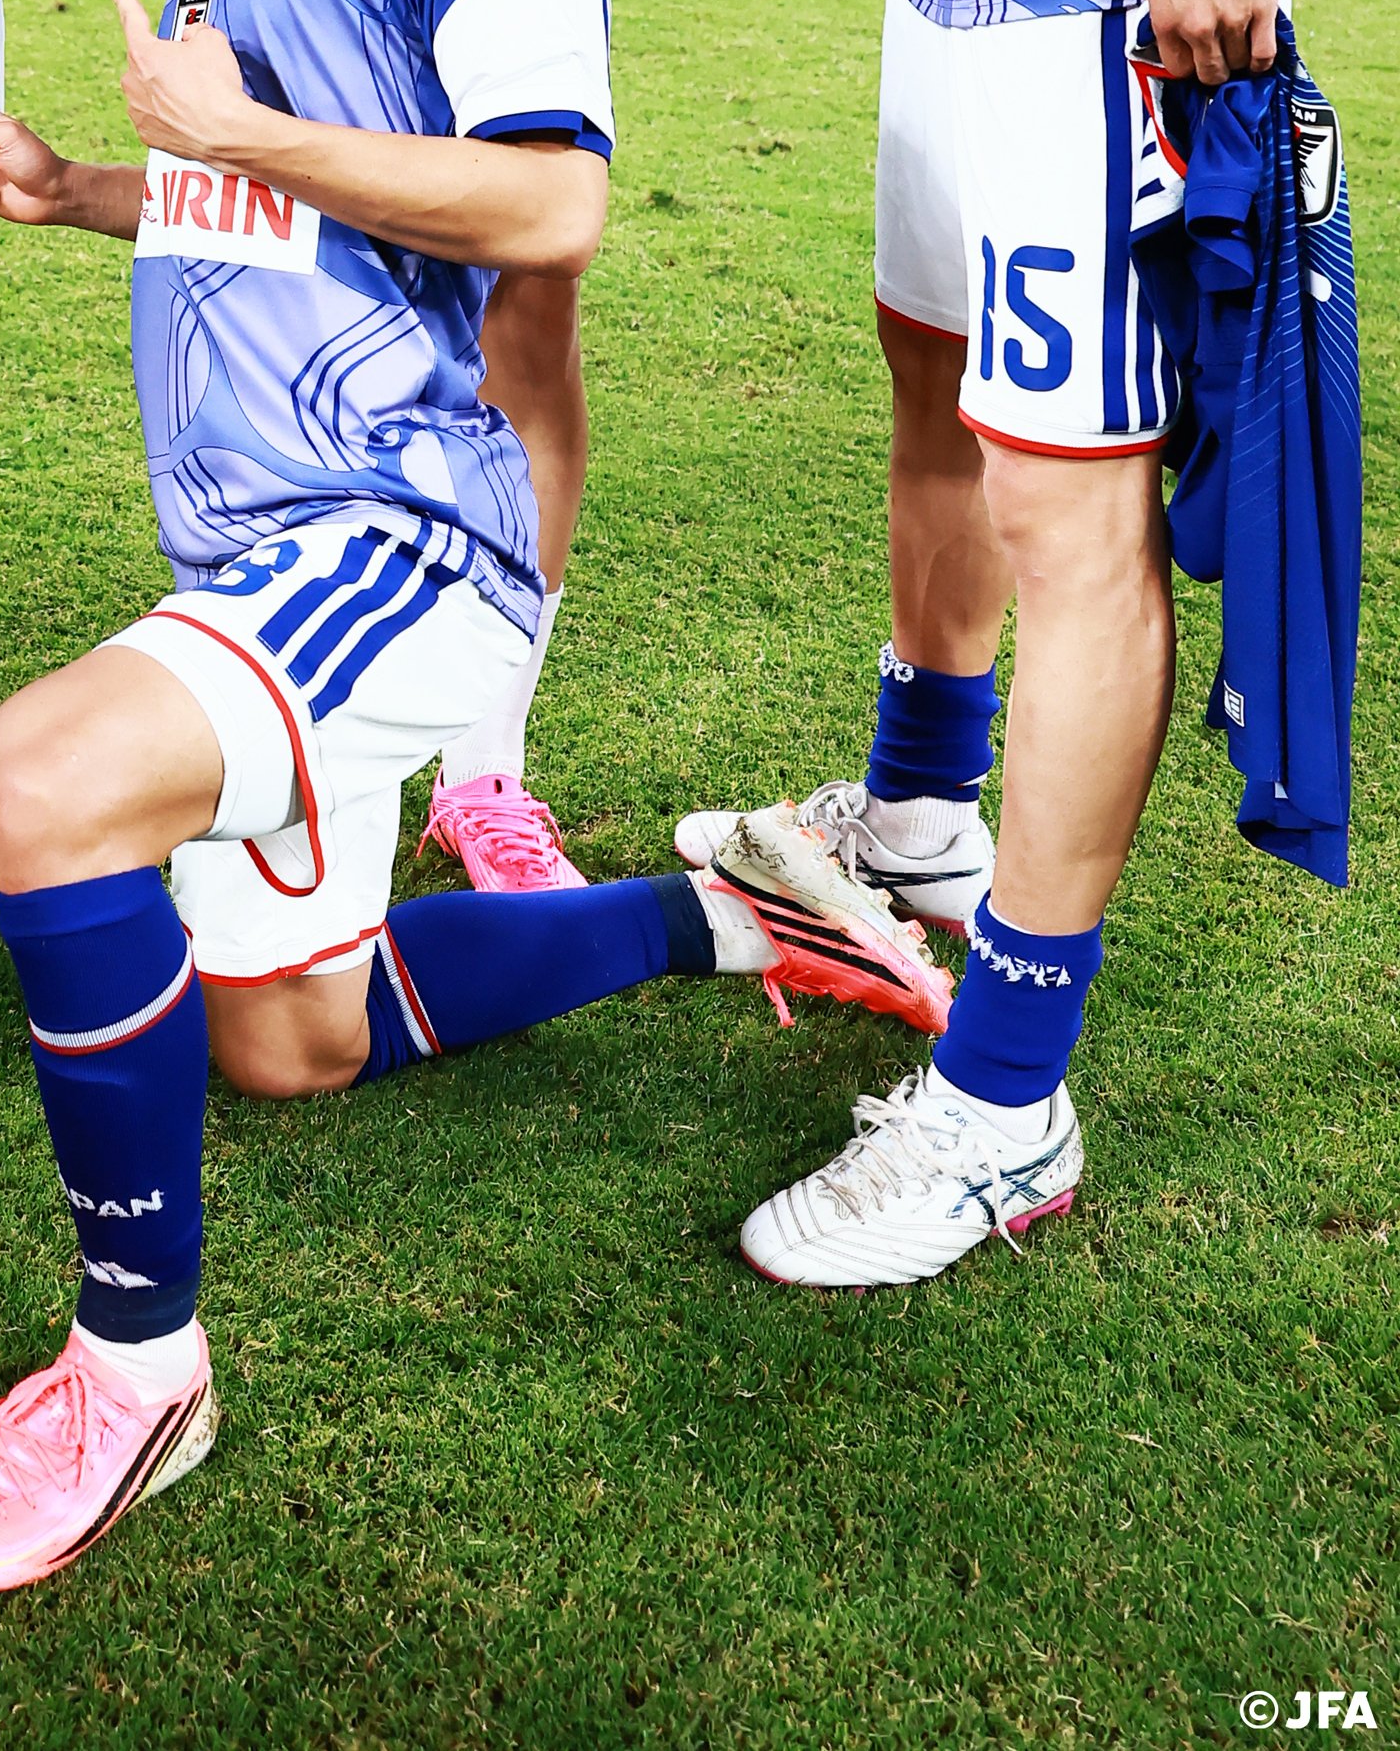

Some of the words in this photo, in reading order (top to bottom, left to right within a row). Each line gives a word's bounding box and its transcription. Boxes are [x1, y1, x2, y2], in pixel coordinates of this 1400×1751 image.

[162, 169, 295, 241] RIN
[979, 234, 1075, 392] 15
[65, 1187, 164, 1217] PAN
